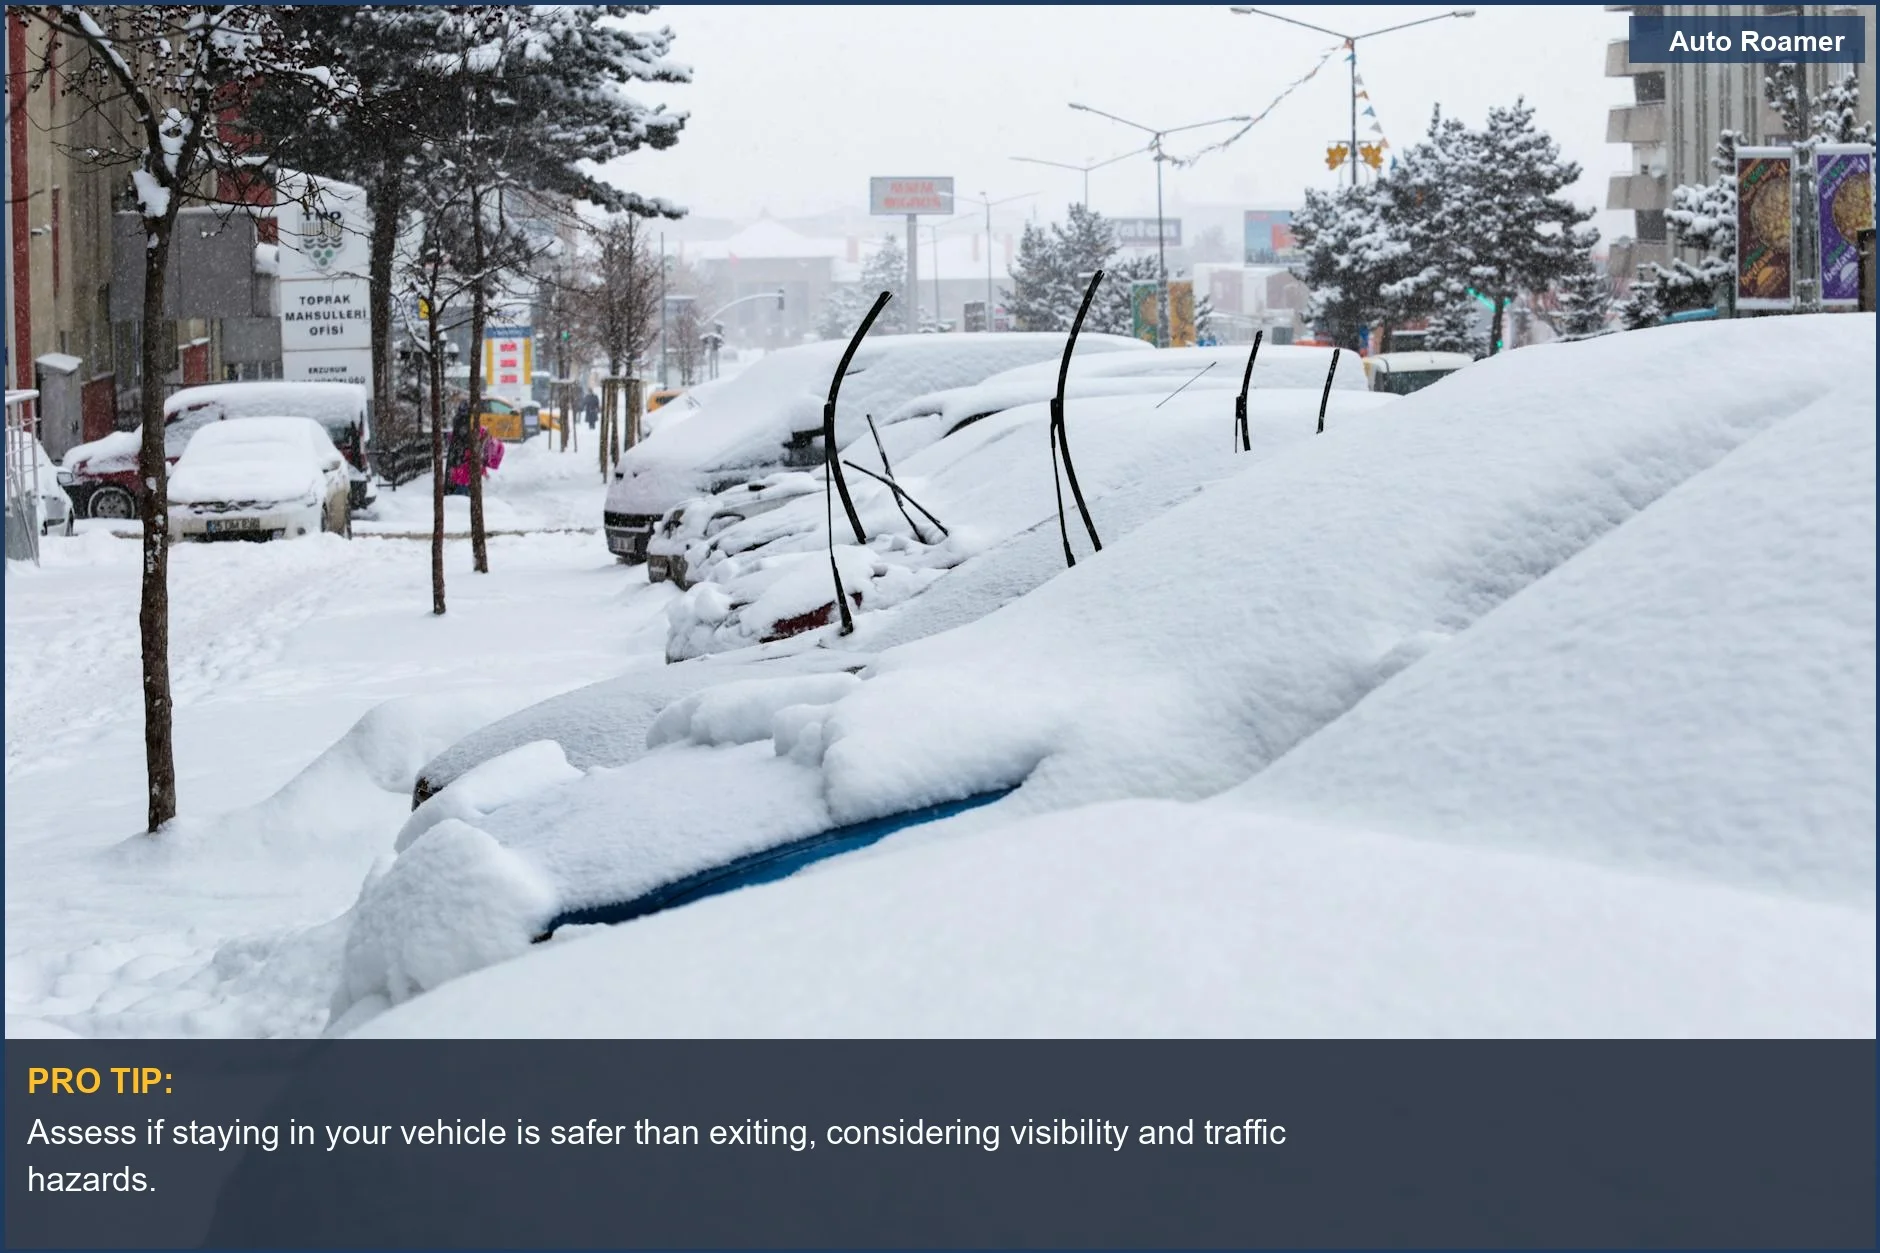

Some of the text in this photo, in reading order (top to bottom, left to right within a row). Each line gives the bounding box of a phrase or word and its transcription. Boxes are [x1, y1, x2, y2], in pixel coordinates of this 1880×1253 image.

[299, 294, 351, 305] TOPRAK
[285, 307, 367, 321] MAHSULLERİ
[309, 323, 343, 336] OFİSİ
[308, 366, 347, 374] ERZURUM
